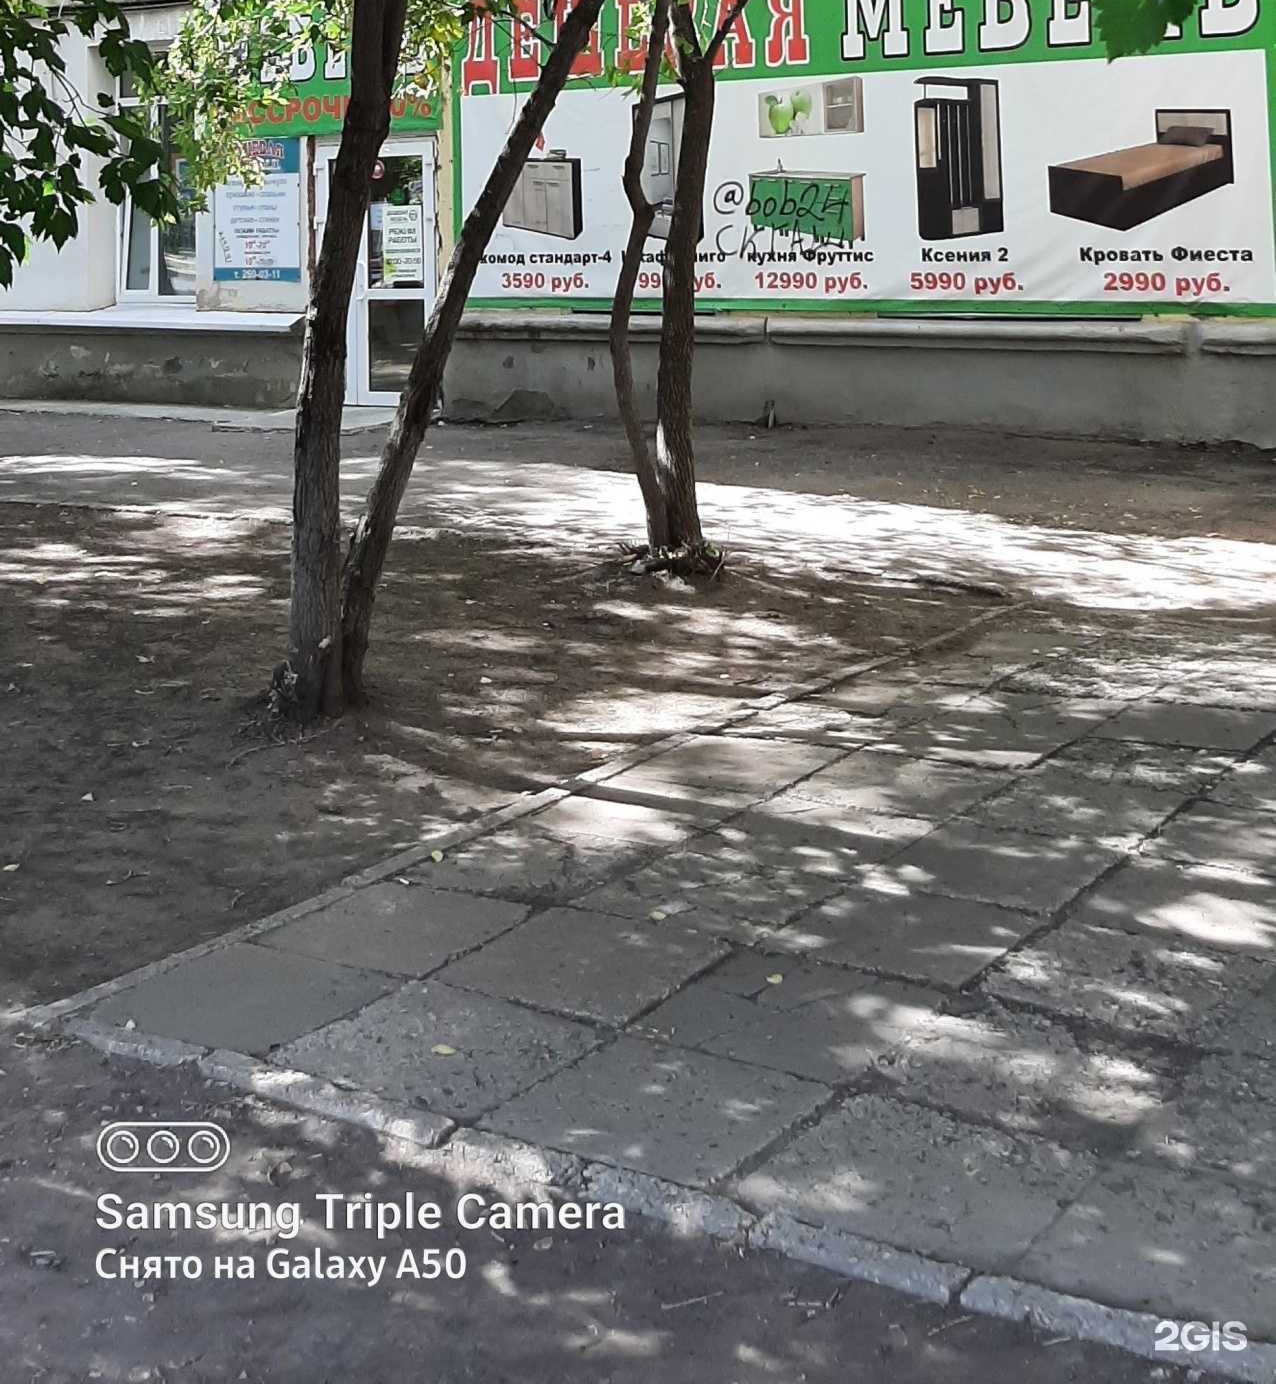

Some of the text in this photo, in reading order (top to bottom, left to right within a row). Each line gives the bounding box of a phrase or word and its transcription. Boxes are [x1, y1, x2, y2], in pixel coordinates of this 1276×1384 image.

[529, 250, 612, 266] стандарт-4
[802, 249, 875, 266] Фруттис
[921, 247, 1009, 263] Ксения 2
[1079, 245, 1254, 265] Кровать Фиеста
[501, 272, 590, 293] 3590 руб.
[693, 272, 722, 293] уб.
[754, 271, 869, 293] 12990 руб.
[910, 271, 1025, 295] 5990 руб.
[1102, 271, 1231, 296] 2990 руб.
